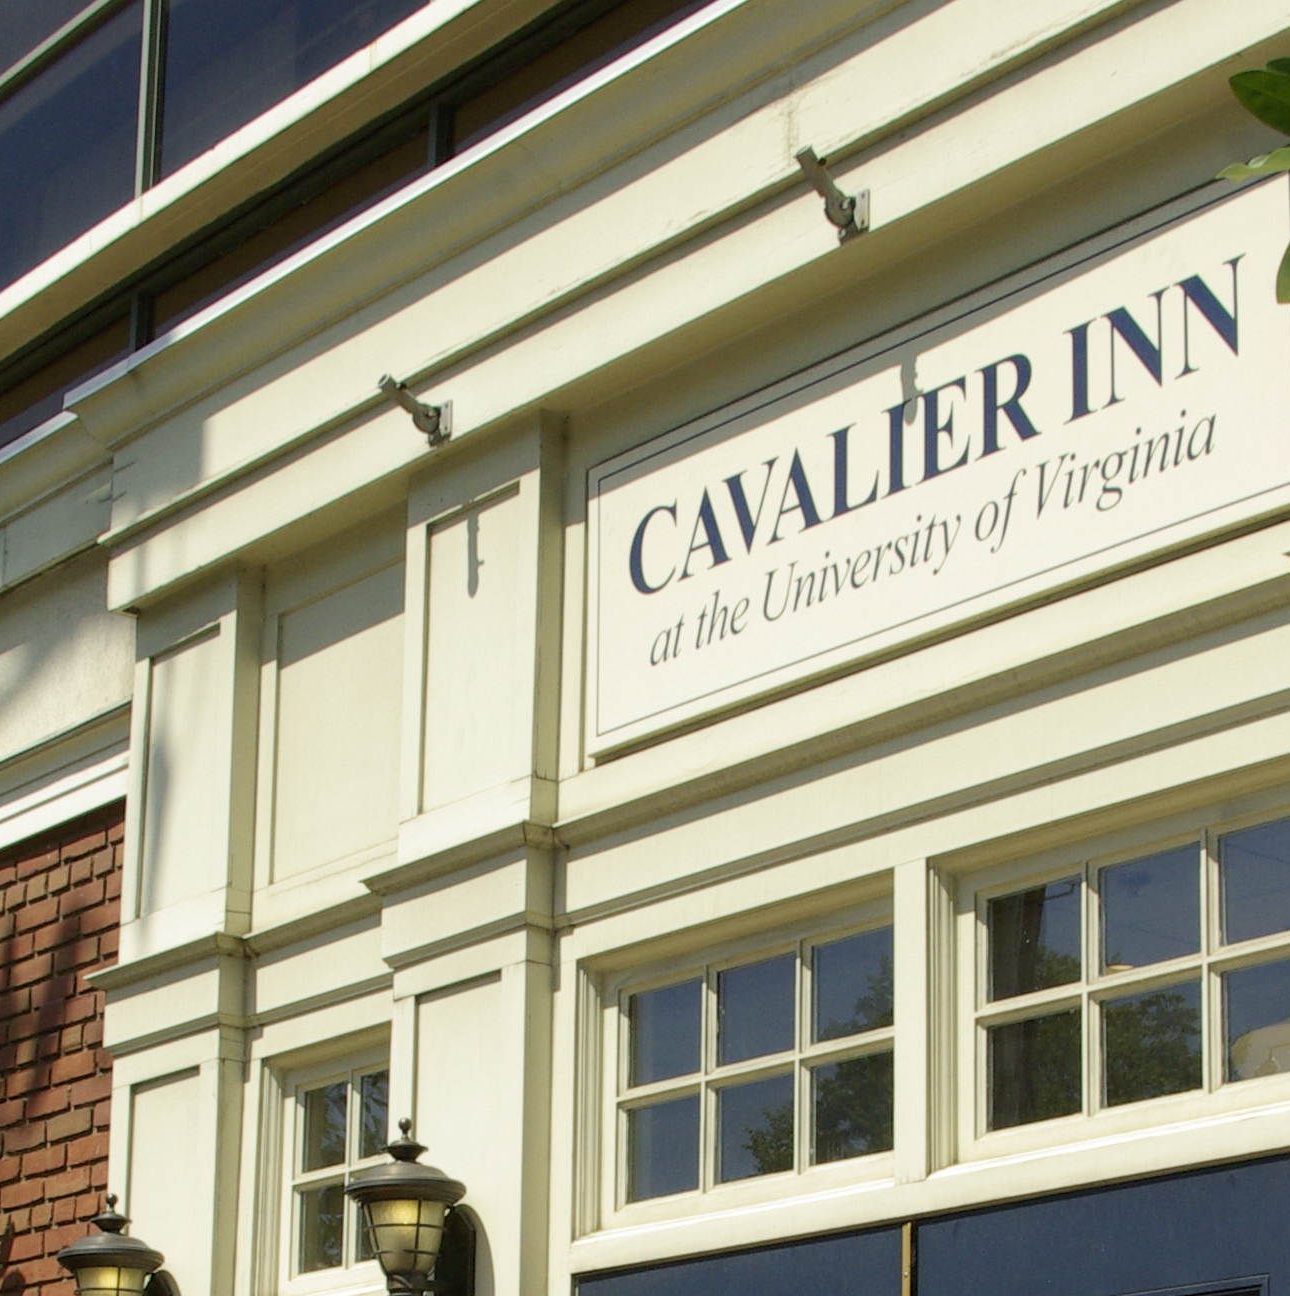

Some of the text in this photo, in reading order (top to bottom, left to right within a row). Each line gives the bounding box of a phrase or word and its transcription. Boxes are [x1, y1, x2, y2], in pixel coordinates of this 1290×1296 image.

[628, 253, 1246, 595] CAVALIER INN
[649, 408, 1218, 667] at the University of Virginia
